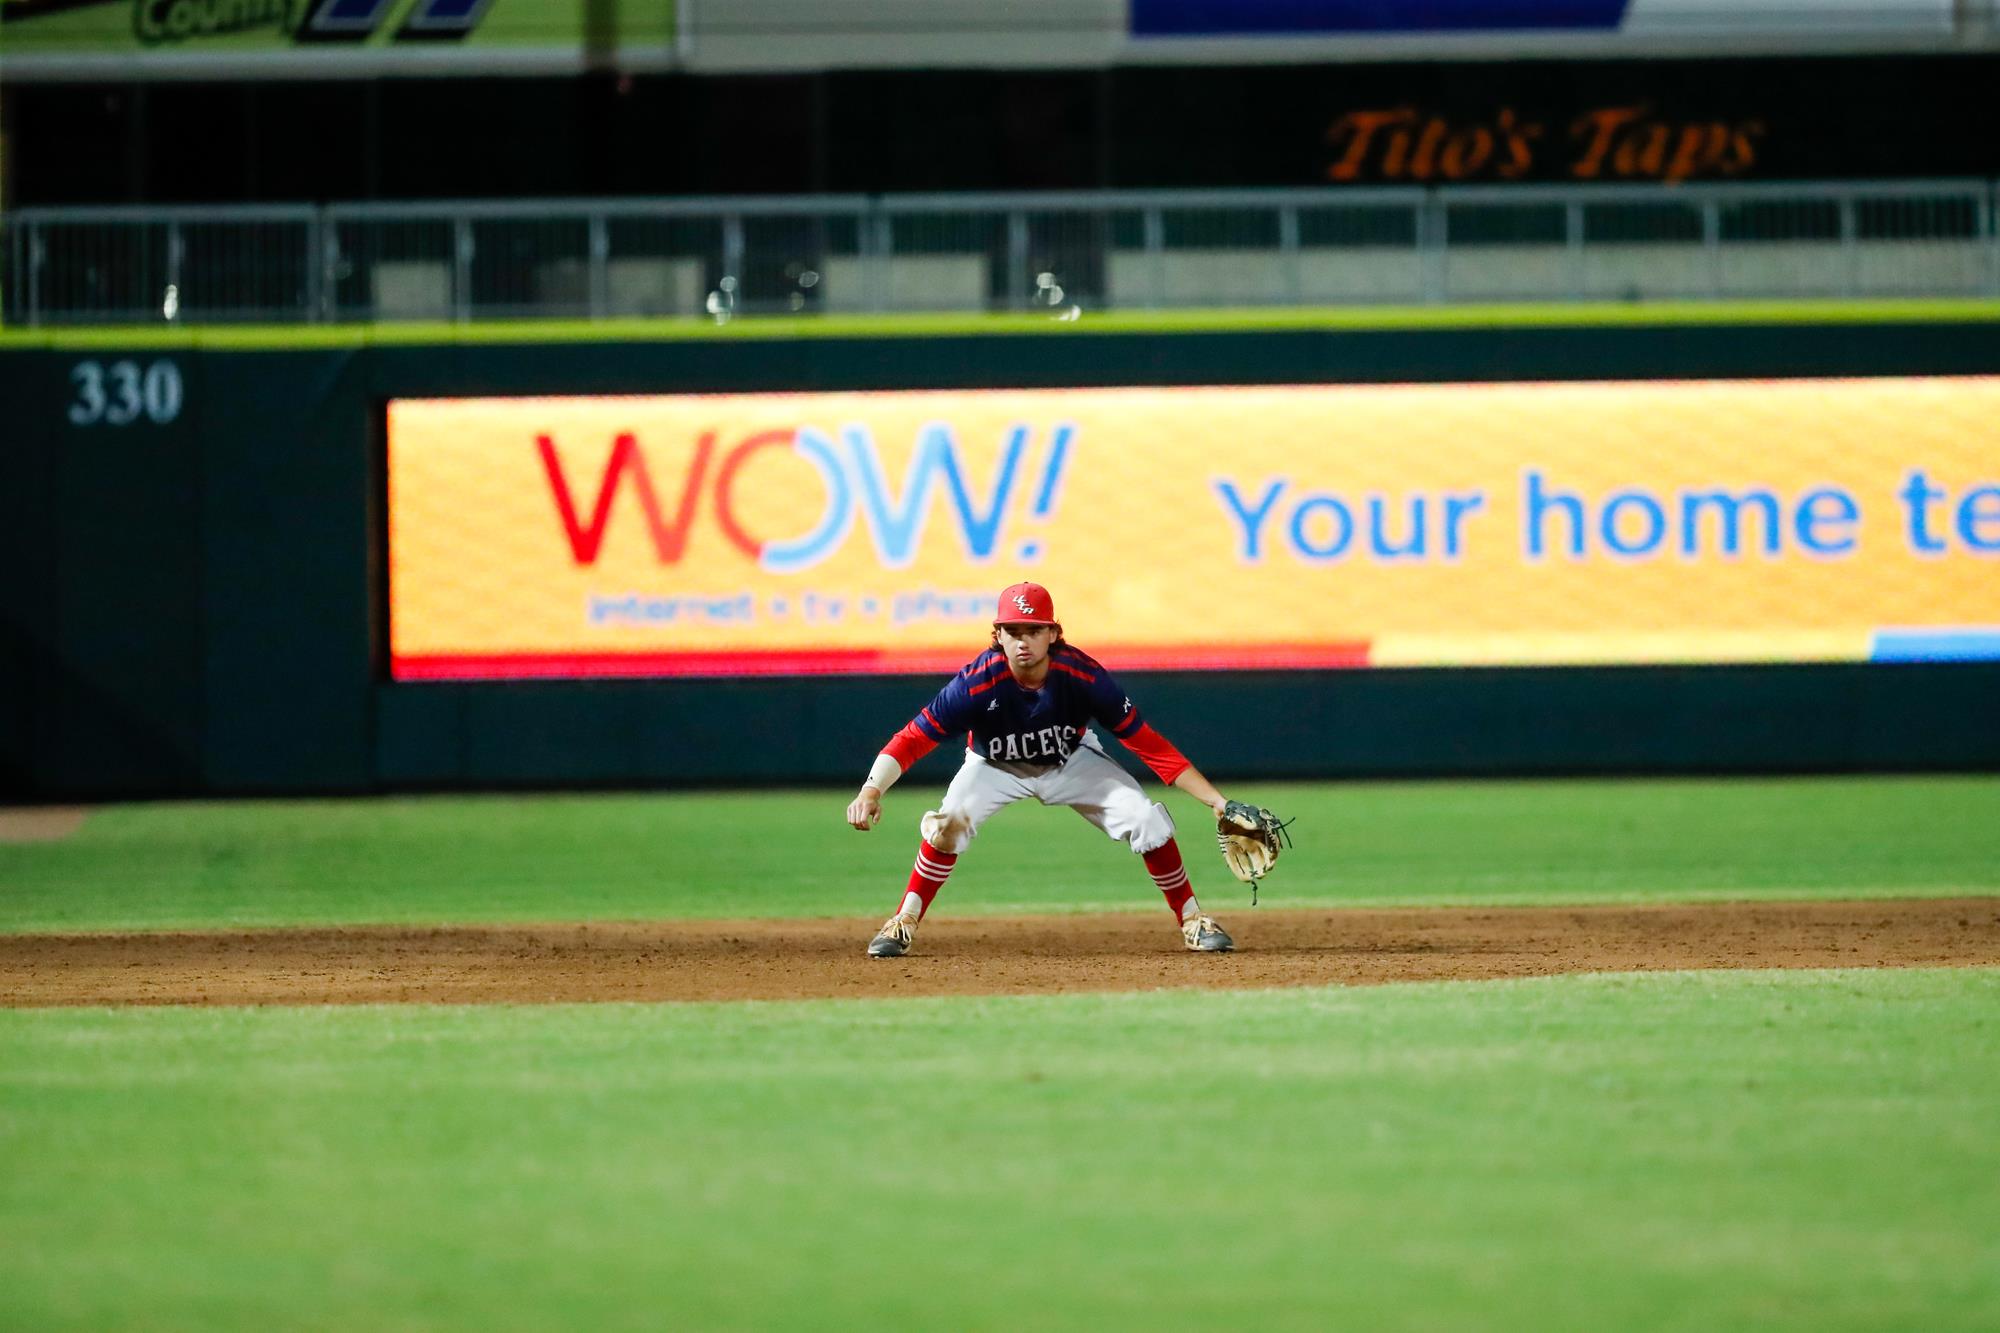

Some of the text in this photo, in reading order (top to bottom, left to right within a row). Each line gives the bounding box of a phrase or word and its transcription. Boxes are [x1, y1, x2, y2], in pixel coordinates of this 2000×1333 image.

[1328, 105, 1766, 187] Tito's Taps
[68, 360, 183, 426] 330
[536, 424, 1076, 568] WOW!
[1214, 478, 1484, 558] Your
[1524, 472, 1859, 556] home
[892, 590, 999, 627] phon
